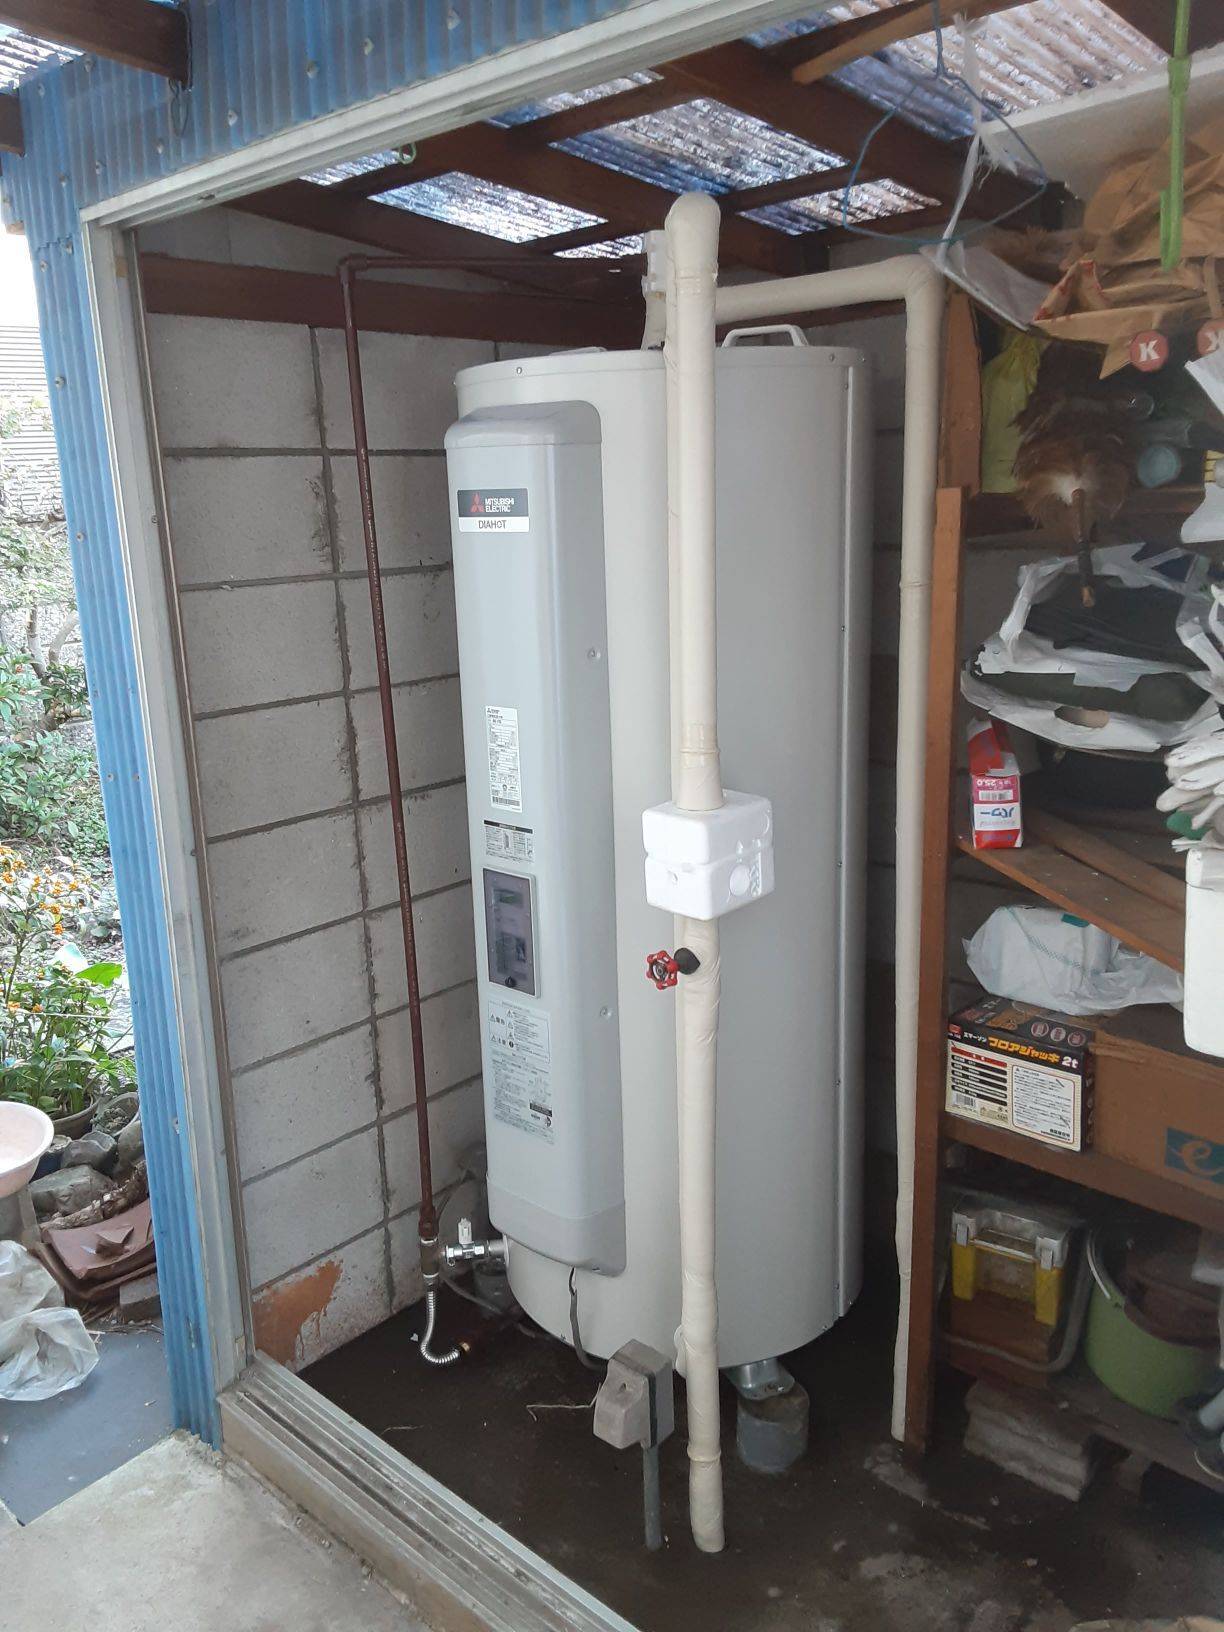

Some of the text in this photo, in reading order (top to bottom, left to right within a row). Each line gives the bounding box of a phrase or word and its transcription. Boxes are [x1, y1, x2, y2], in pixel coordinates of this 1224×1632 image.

[1139, 340, 1160, 362] K
[485, 497, 514, 505] MITSUBISHI
[478, 520, 507, 529] DIAHOT
[988, 1036, 1060, 1063] フロアジャッキ
[1061, 1056, 1079, 1069] 2t
